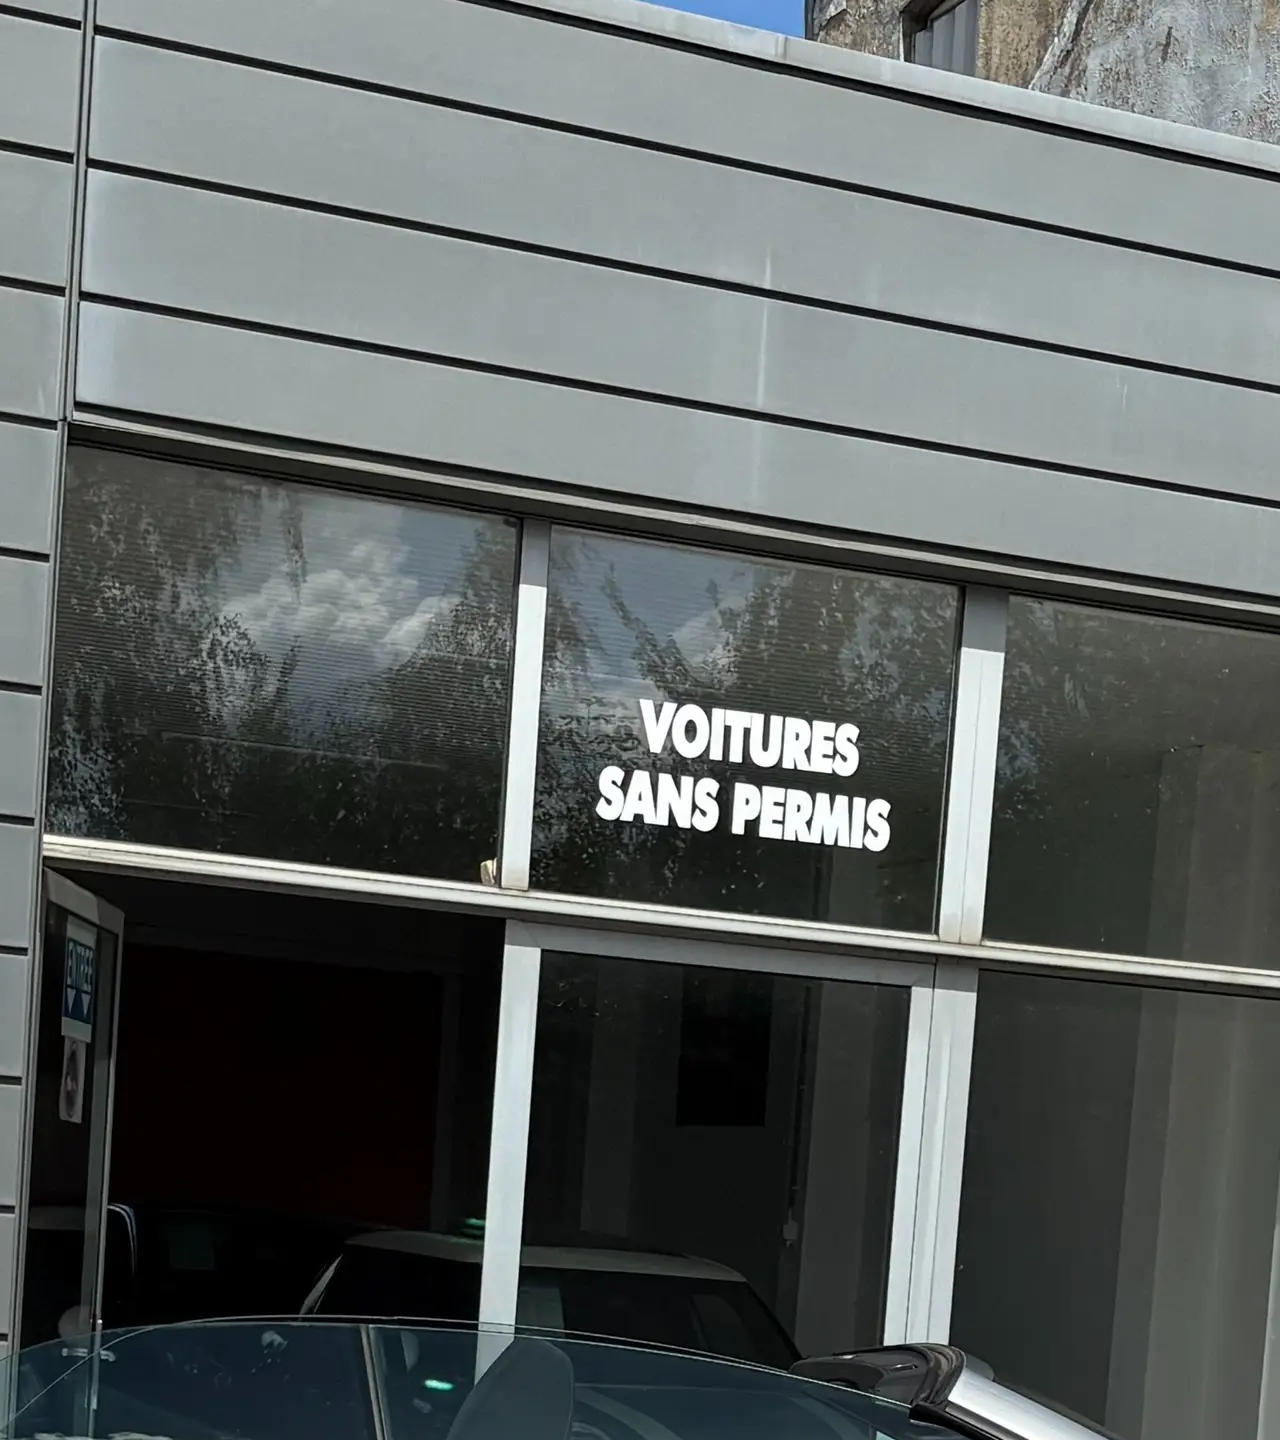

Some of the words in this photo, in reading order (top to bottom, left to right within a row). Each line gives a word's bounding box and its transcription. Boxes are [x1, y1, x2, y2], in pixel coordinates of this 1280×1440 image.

[639, 699, 860, 777] VOITURES
[595, 765, 720, 833] SANS
[731, 782, 891, 852] PERMIS
